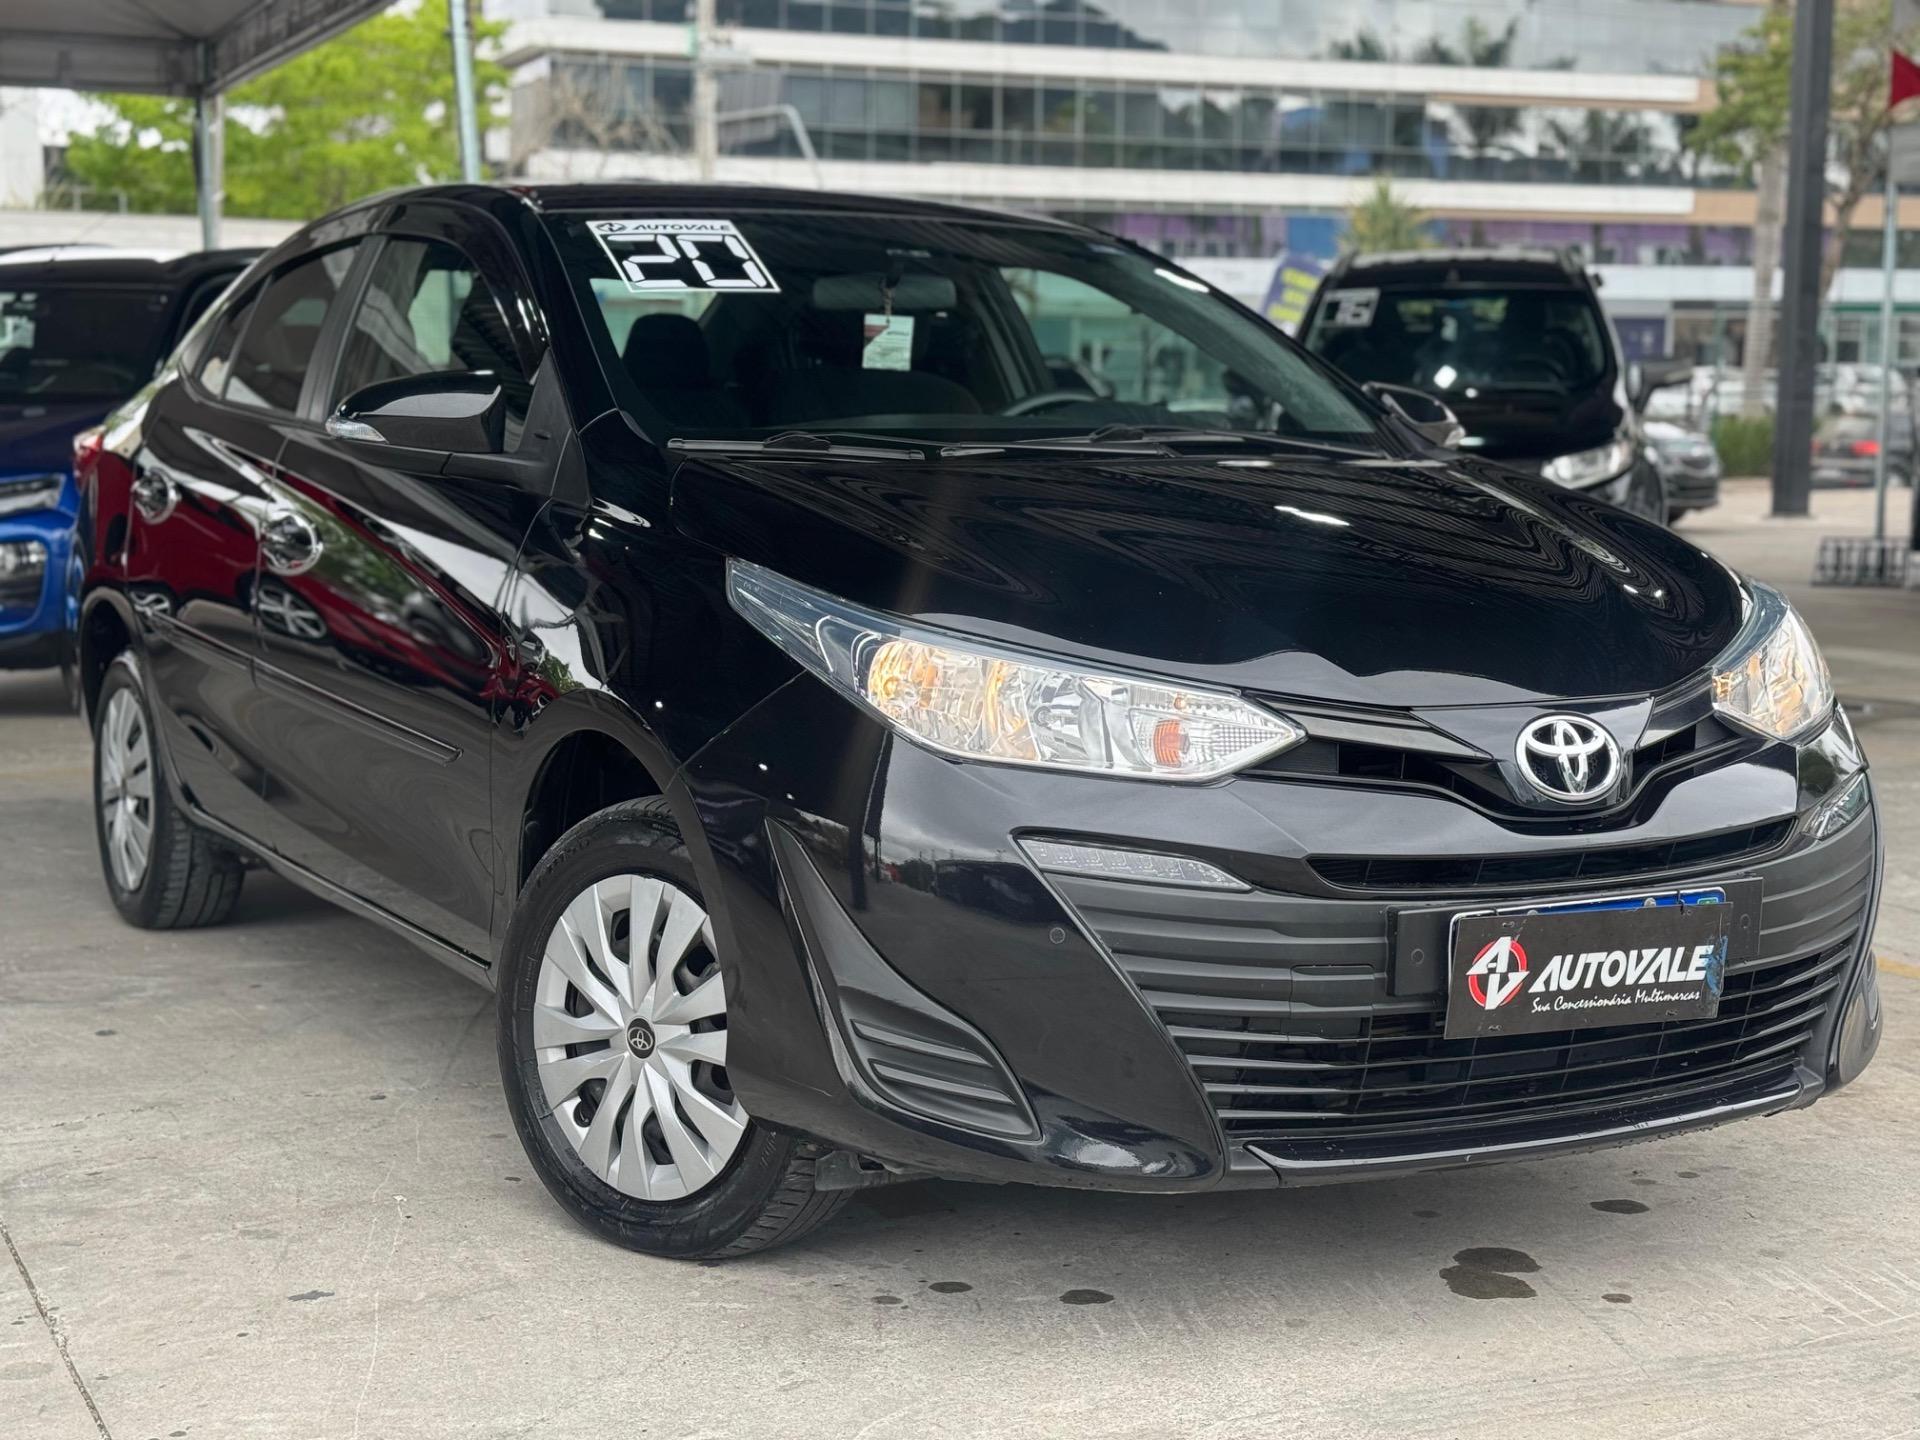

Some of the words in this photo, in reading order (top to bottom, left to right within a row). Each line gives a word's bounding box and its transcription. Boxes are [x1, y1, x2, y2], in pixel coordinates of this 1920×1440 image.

[632, 223, 731, 231] AUTOVALE
[607, 234, 768, 288] 20
[1528, 945, 1714, 993] AUTOVALE
[1531, 997, 1551, 1013] Sua
[1635, 988, 1700, 1004] Multimarcas
